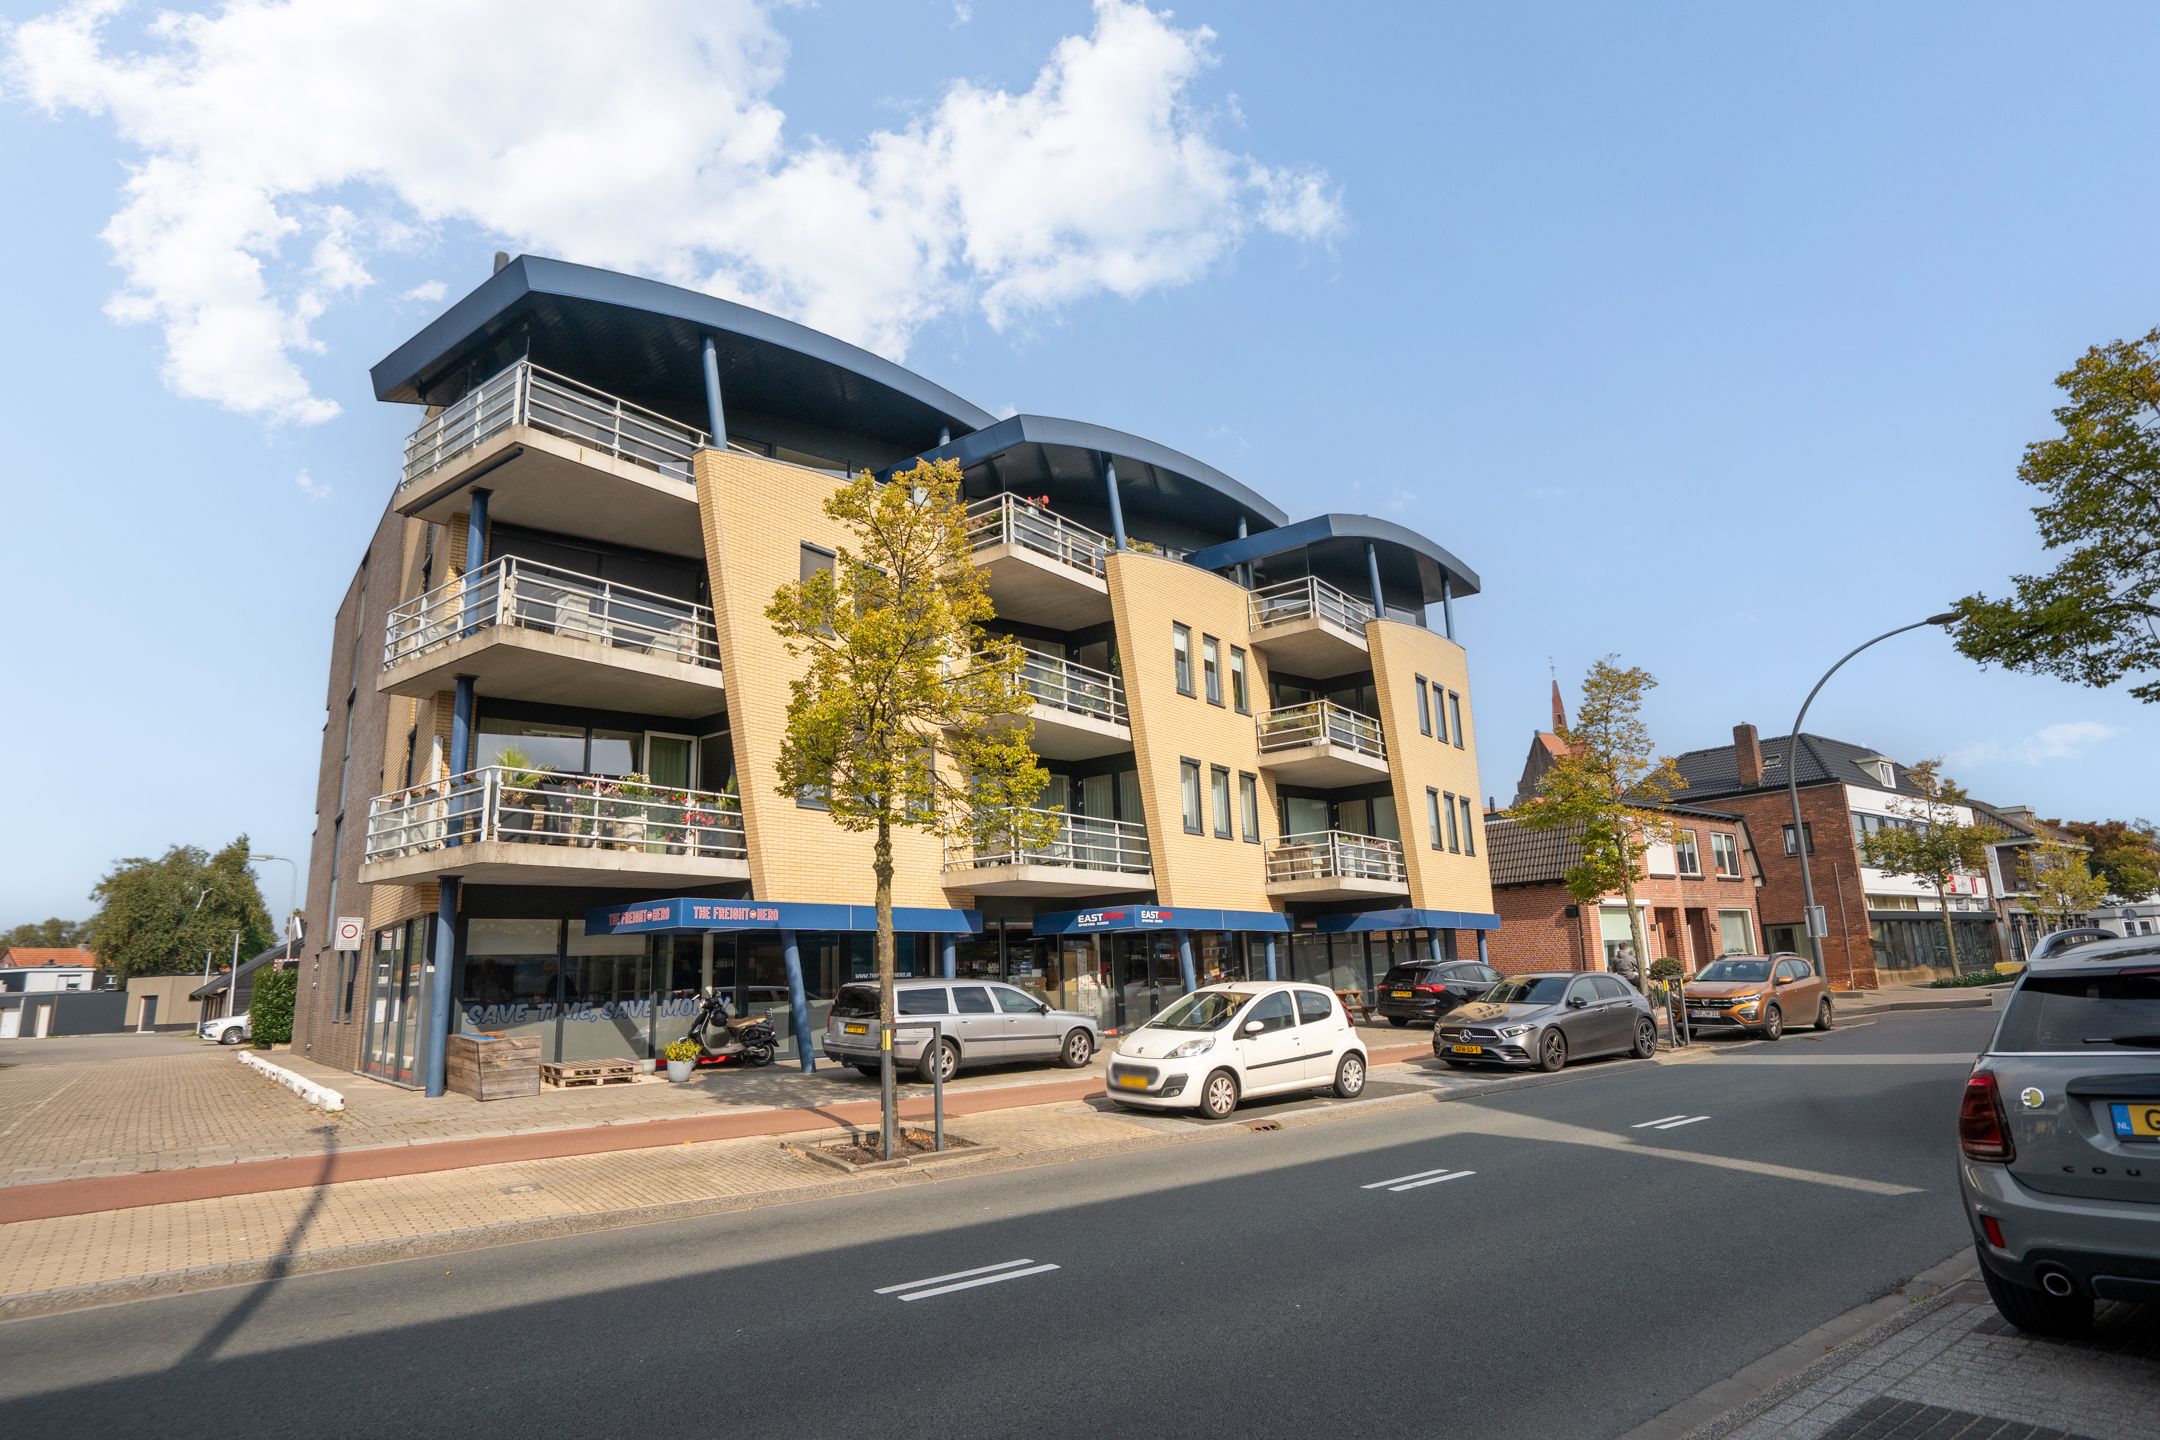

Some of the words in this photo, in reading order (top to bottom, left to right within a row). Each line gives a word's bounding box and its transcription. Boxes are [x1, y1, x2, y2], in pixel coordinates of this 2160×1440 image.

[609, 913, 620, 926] THE
[621, 909, 647, 925] FREIGHT
[652, 907, 671, 921] HERO
[693, 905, 711, 920] THE
[713, 906, 750, 921] FREIGHT
[756, 908, 779, 922] HERO
[466, 1003, 529, 1026] SAVE
[537, 1001, 598, 1023] TIME,
[599, 999, 652, 1021] SAVE
[661, 996, 732, 1018] MONY
[2117, 1121, 2131, 1130] NL
[2062, 1165, 2141, 1177] COU
